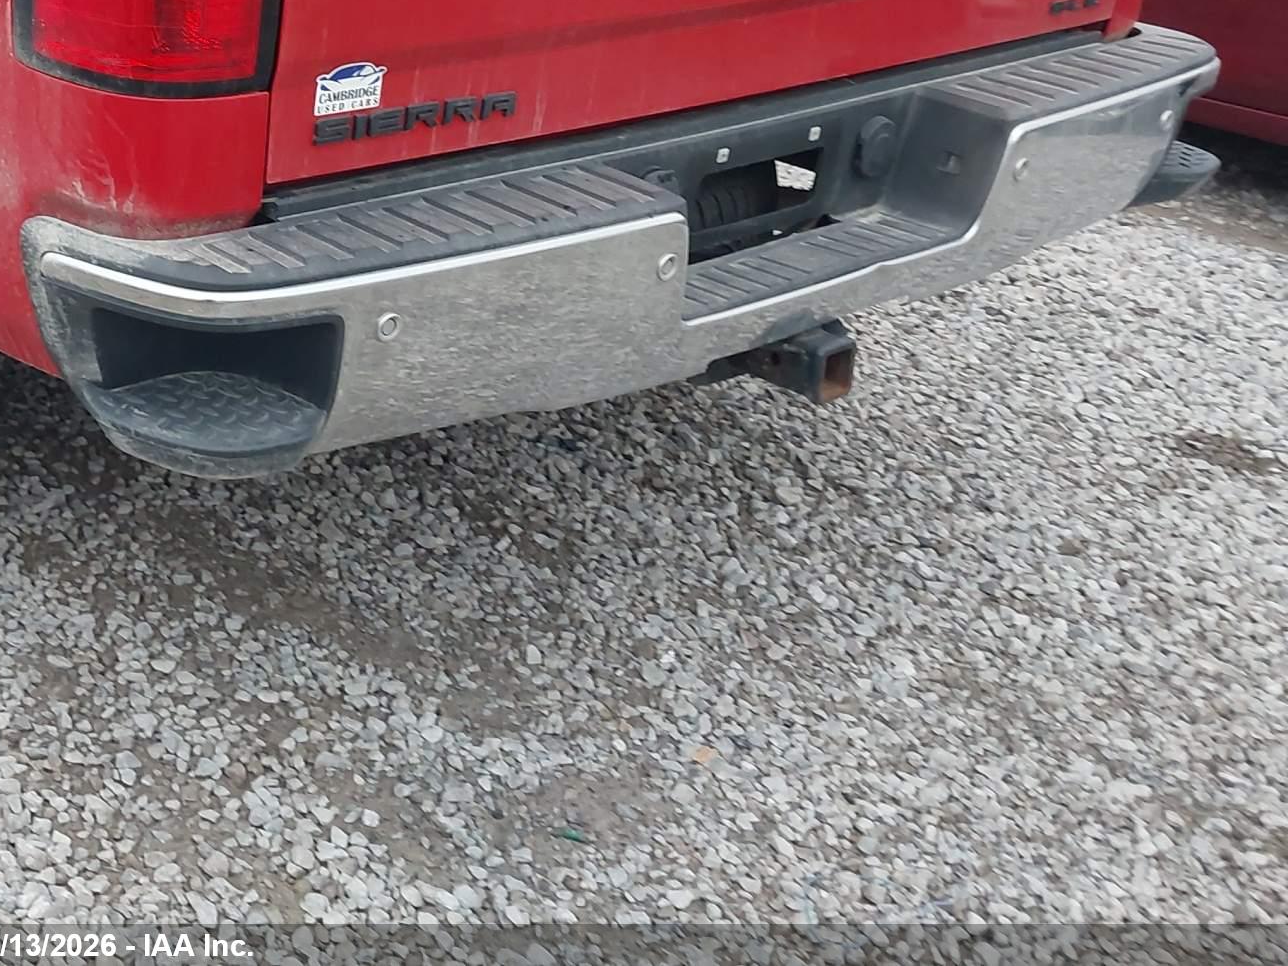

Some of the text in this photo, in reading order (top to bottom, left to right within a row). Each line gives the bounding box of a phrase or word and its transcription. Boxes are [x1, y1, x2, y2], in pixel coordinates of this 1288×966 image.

[318, 85, 380, 105] CAMBRIDGE
[317, 97, 379, 114] USED CARS
[314, 91, 517, 145] SIERRA
